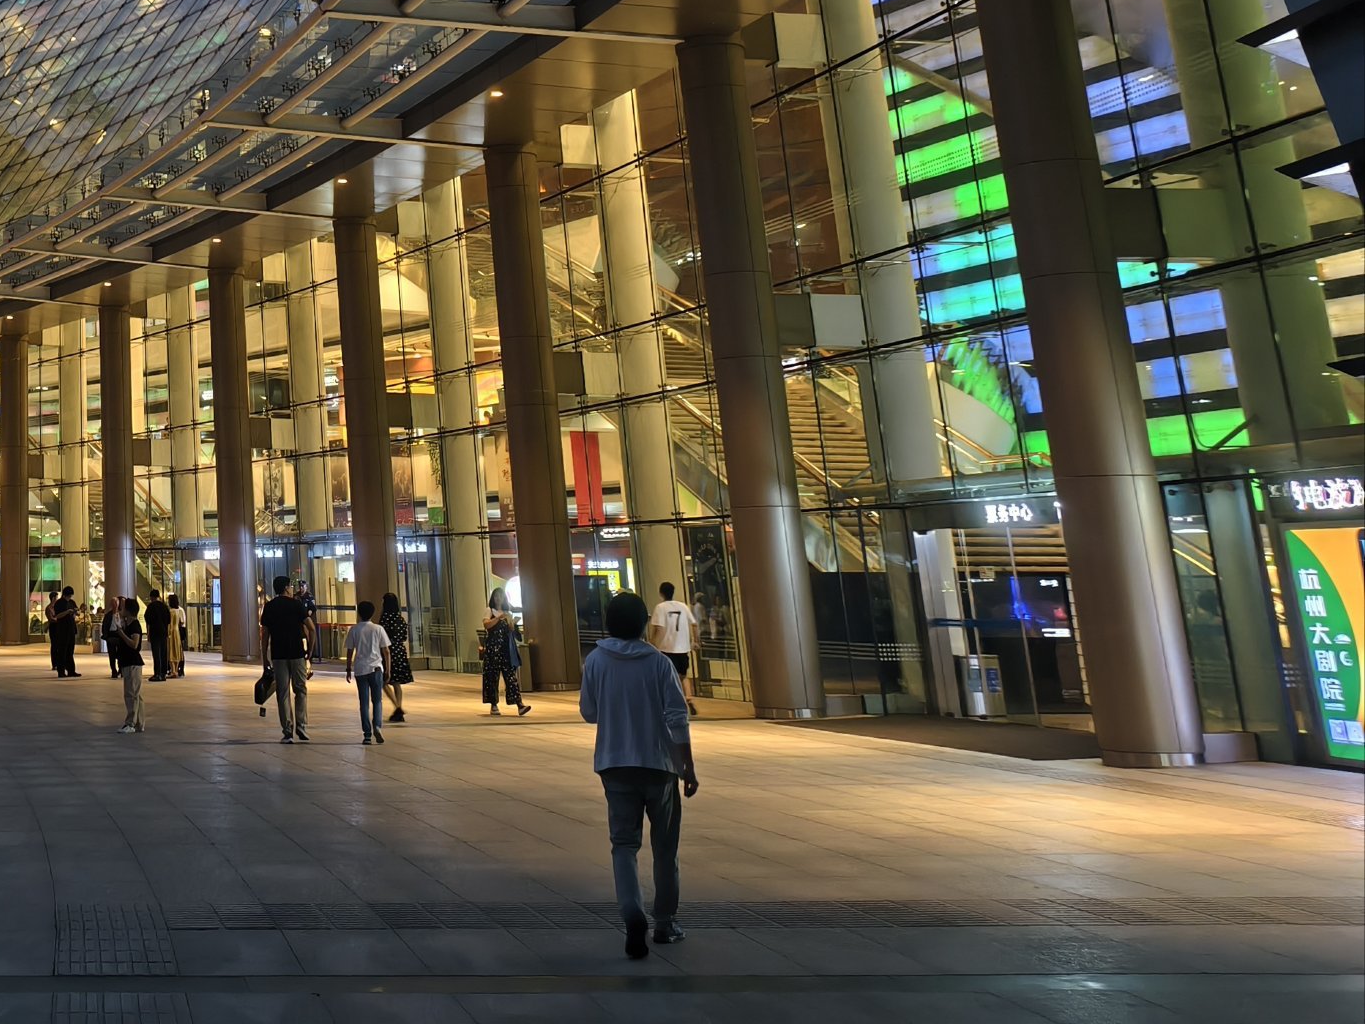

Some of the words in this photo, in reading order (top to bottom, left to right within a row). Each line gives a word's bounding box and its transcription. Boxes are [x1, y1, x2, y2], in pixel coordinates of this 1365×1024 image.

[668, 610, 681, 632] 7
[1298, 568, 1345, 701] 杭州大剧院
